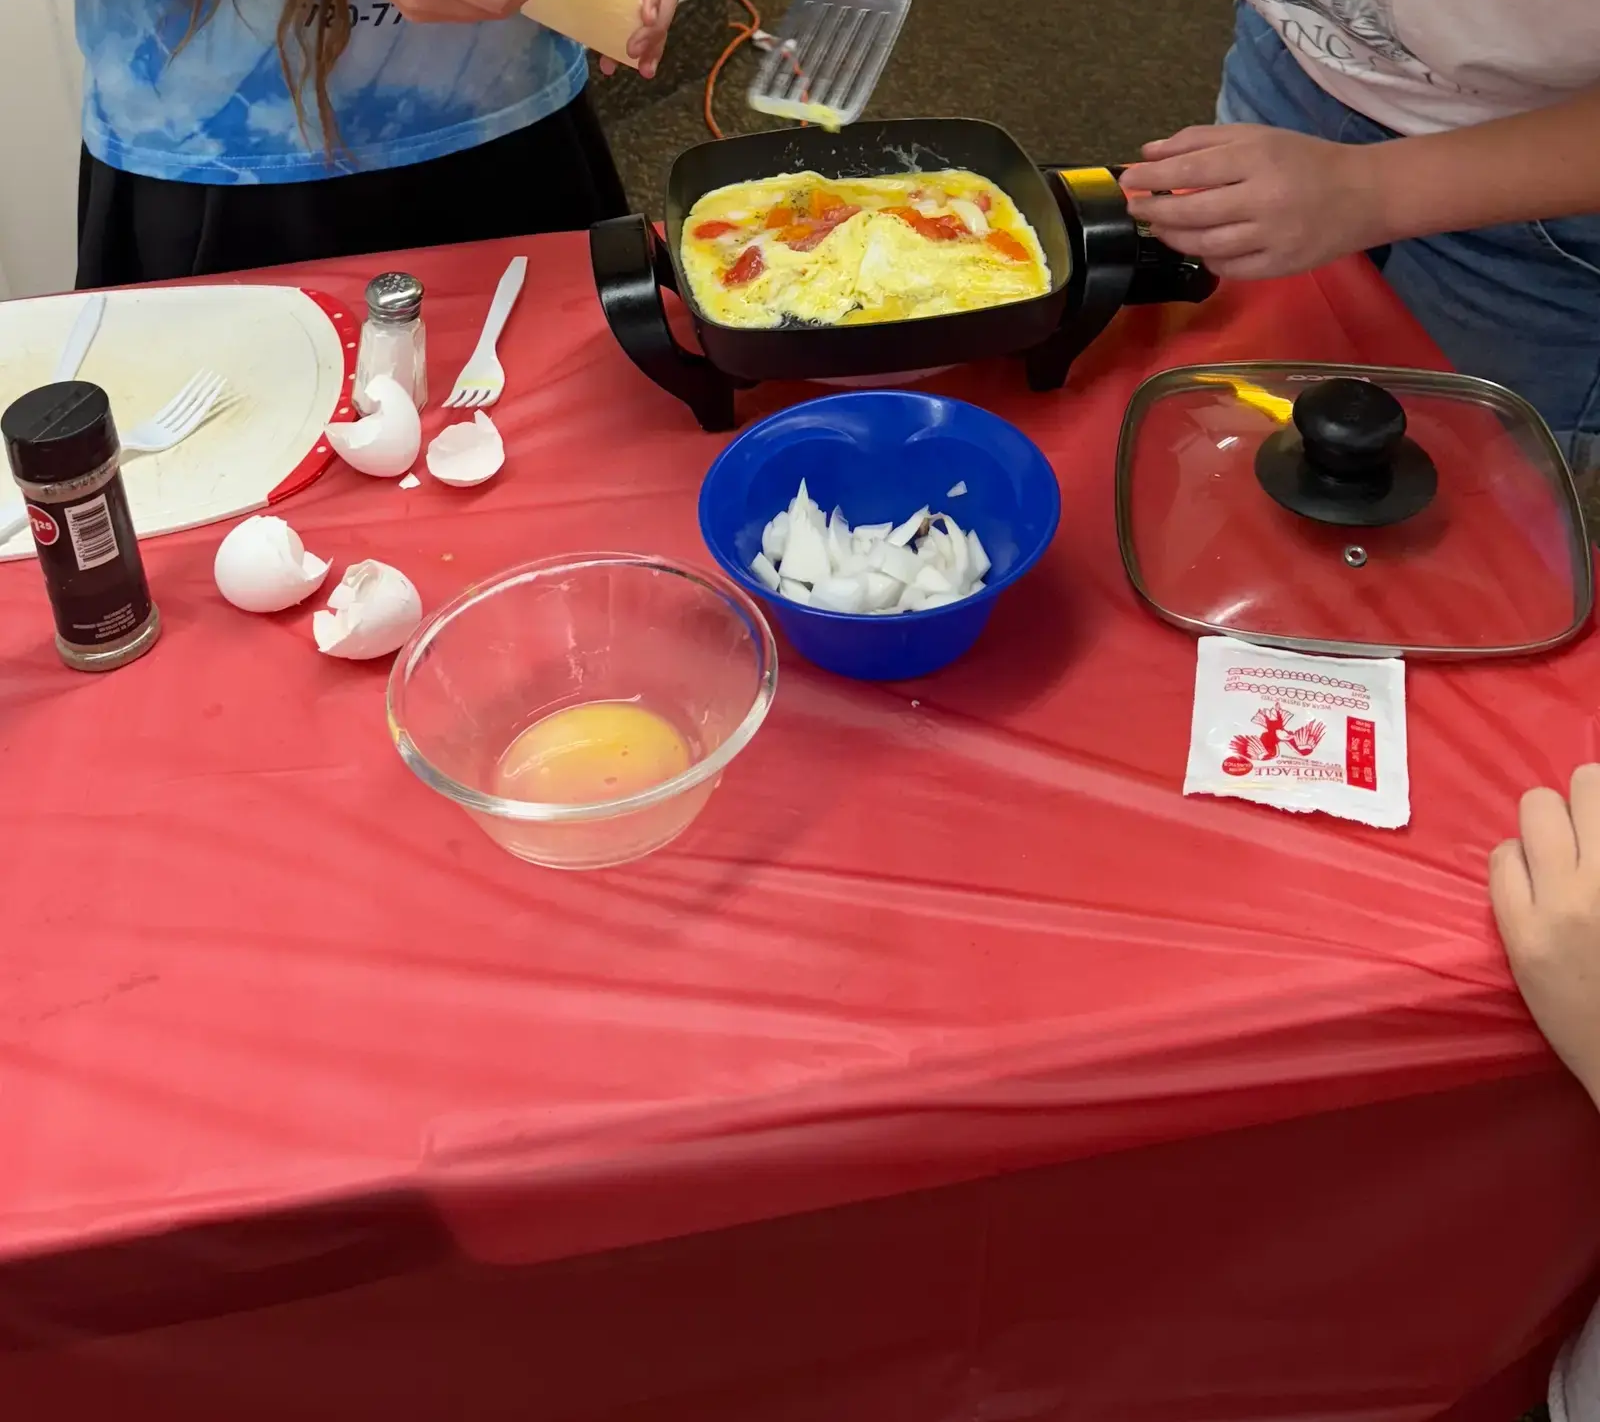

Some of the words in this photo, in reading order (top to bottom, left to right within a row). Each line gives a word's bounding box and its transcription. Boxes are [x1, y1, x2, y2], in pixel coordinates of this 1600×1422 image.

[1301, 699, 1310, 707] AS
[1255, 765, 1301, 777] EAGLE
[1304, 766, 1343, 778] BALD
